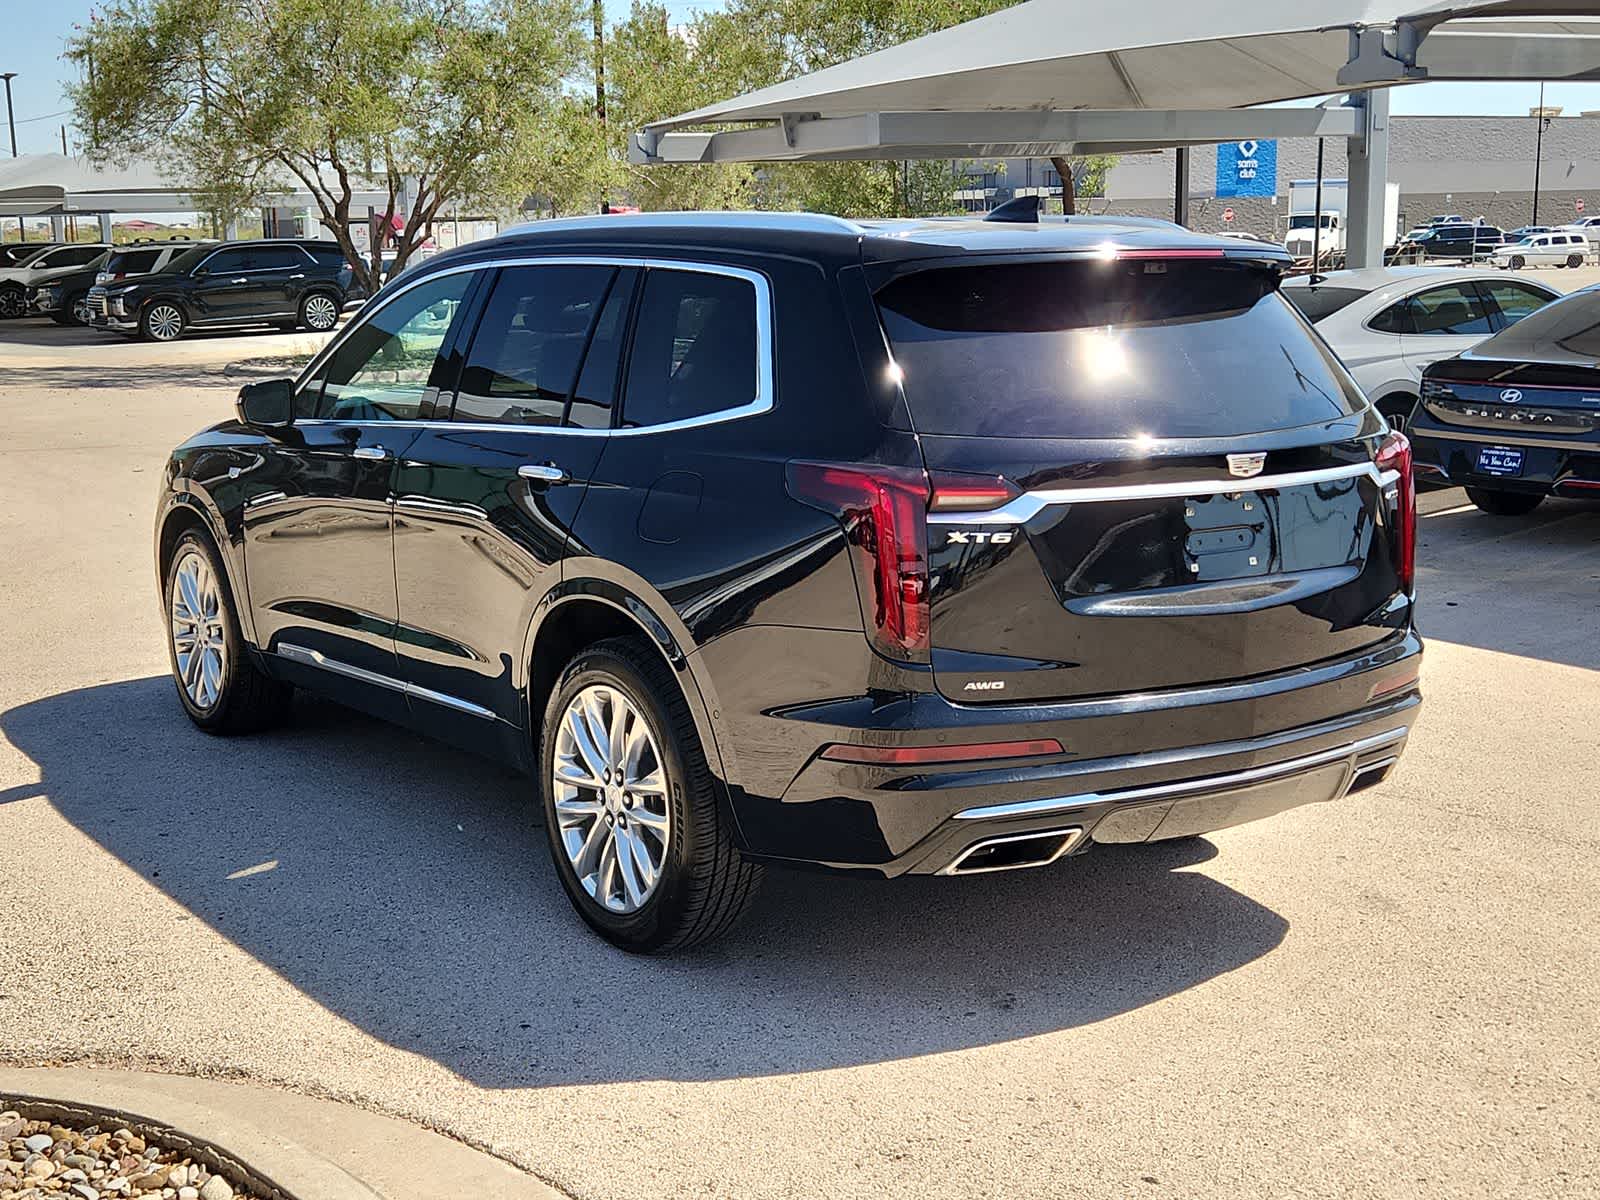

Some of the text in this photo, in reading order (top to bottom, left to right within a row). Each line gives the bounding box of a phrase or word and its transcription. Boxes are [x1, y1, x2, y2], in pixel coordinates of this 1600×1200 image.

[1239, 168, 1256, 179] club
[1464, 407, 1553, 422] SONATA
[946, 531, 1013, 544] XT6
[963, 681, 1005, 690] AWD
